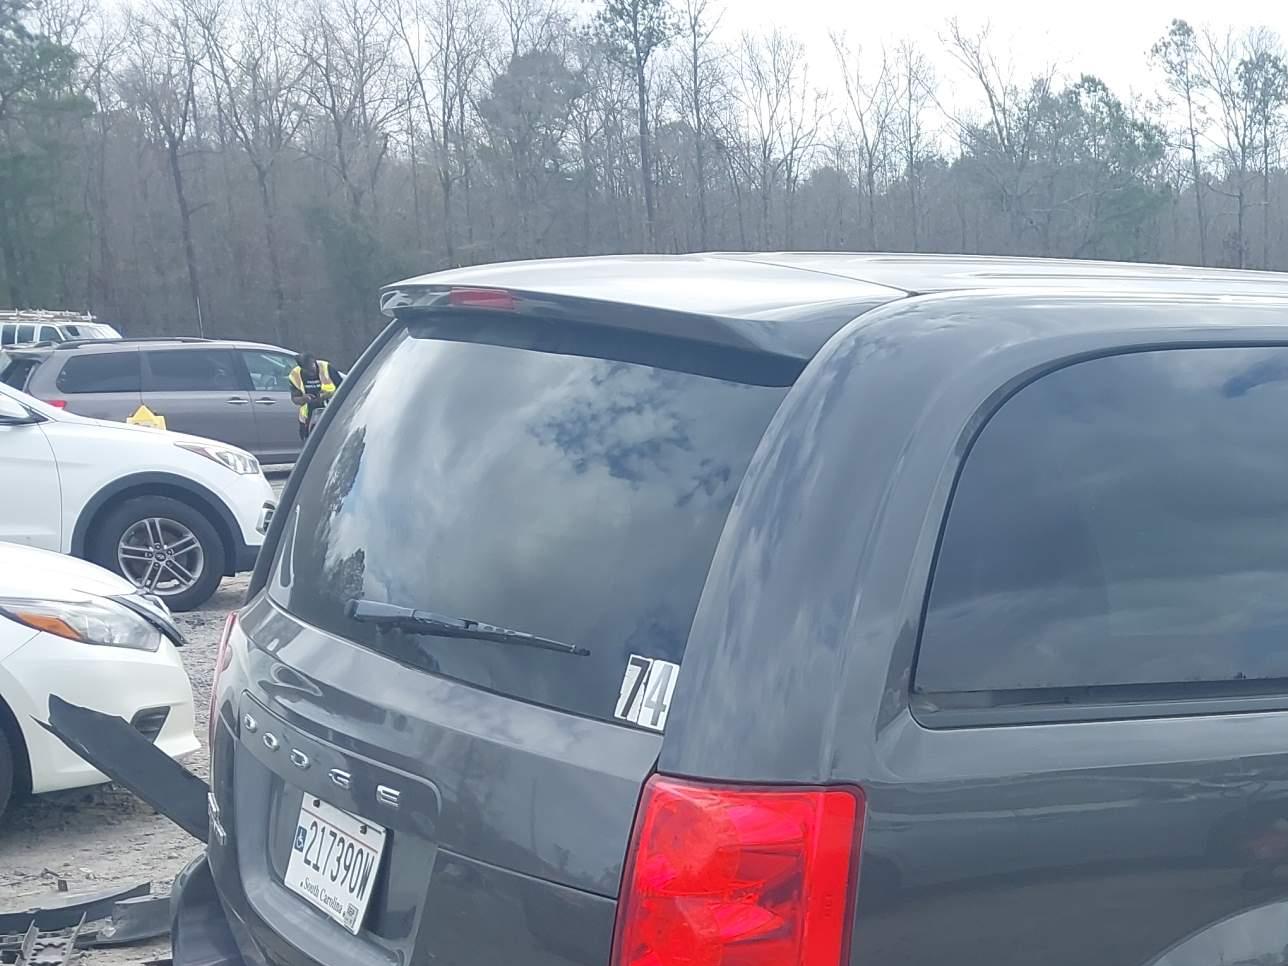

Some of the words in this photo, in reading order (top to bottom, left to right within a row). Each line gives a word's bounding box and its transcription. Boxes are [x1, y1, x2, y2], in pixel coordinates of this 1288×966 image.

[620, 656, 674, 727] 74
[243, 713, 401, 808] DODGE
[303, 820, 375, 902] 217390W
[303, 877, 320, 897] South
[320, 888, 343, 914] Carolina
